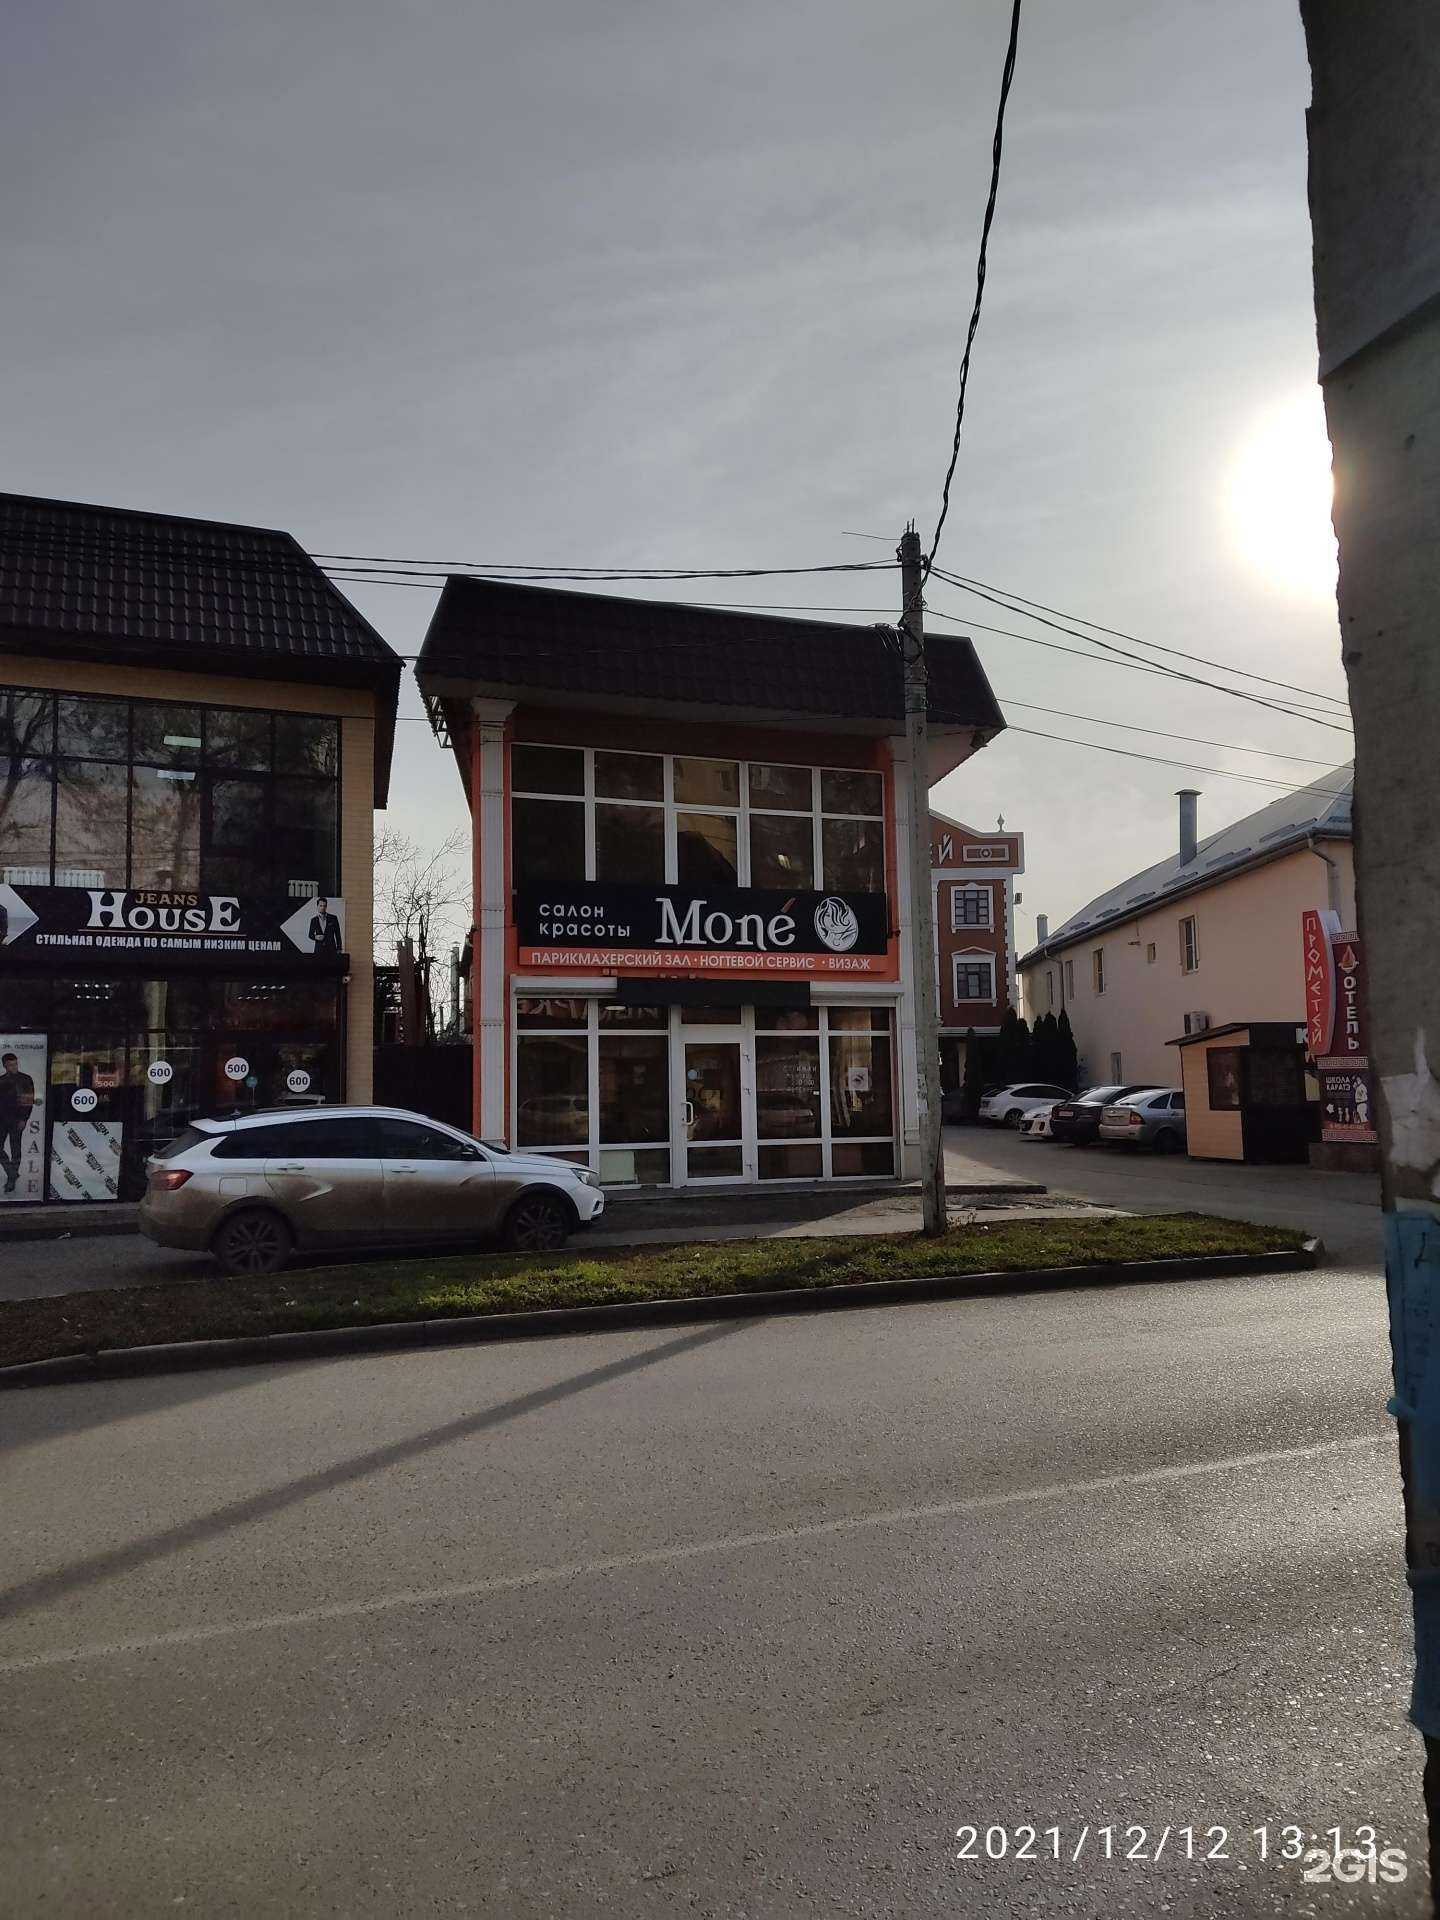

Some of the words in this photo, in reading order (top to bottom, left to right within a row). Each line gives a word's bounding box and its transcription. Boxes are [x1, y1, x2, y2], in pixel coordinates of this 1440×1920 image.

[135, 893, 198, 907] JEANS
[539, 903, 604, 920] салон
[539, 922, 631, 939] красоты
[655, 897, 796, 951] Moné
[36, 933, 94, 947] СТИЛЬНАЯ
[95, 935, 142, 949] ОДЕЖДА
[143, 937, 158, 949] ПО
[160, 936, 202, 949] САМЫМ
[204, 938, 246, 951] НИЗКИМ
[248, 939, 281, 952] ЦЕНАМ
[531, 951, 662, 967] ПАРИКМАХЕРСКИЙ
[664, 953, 692, 967] ЗАЛ
[700, 952, 765, 969] НОГТЕВОЙ
[767, 956, 816, 969] СЕРВИС
[828, 957, 871, 971] ВИЗАЖ
[1305, 916, 1324, 1046] ПРОМЕТЕЙ
[1343, 976, 1361, 1051] ОТЕЛЬ
[149, 1067, 171, 1078] 600
[227, 1063, 248, 1074] 500
[288, 1076, 309, 1087] 600
[1325, 1076, 1350, 1084] ШКОЛА
[73, 1095, 96, 1106] 600
[27, 1120, 41, 1194] SALE
